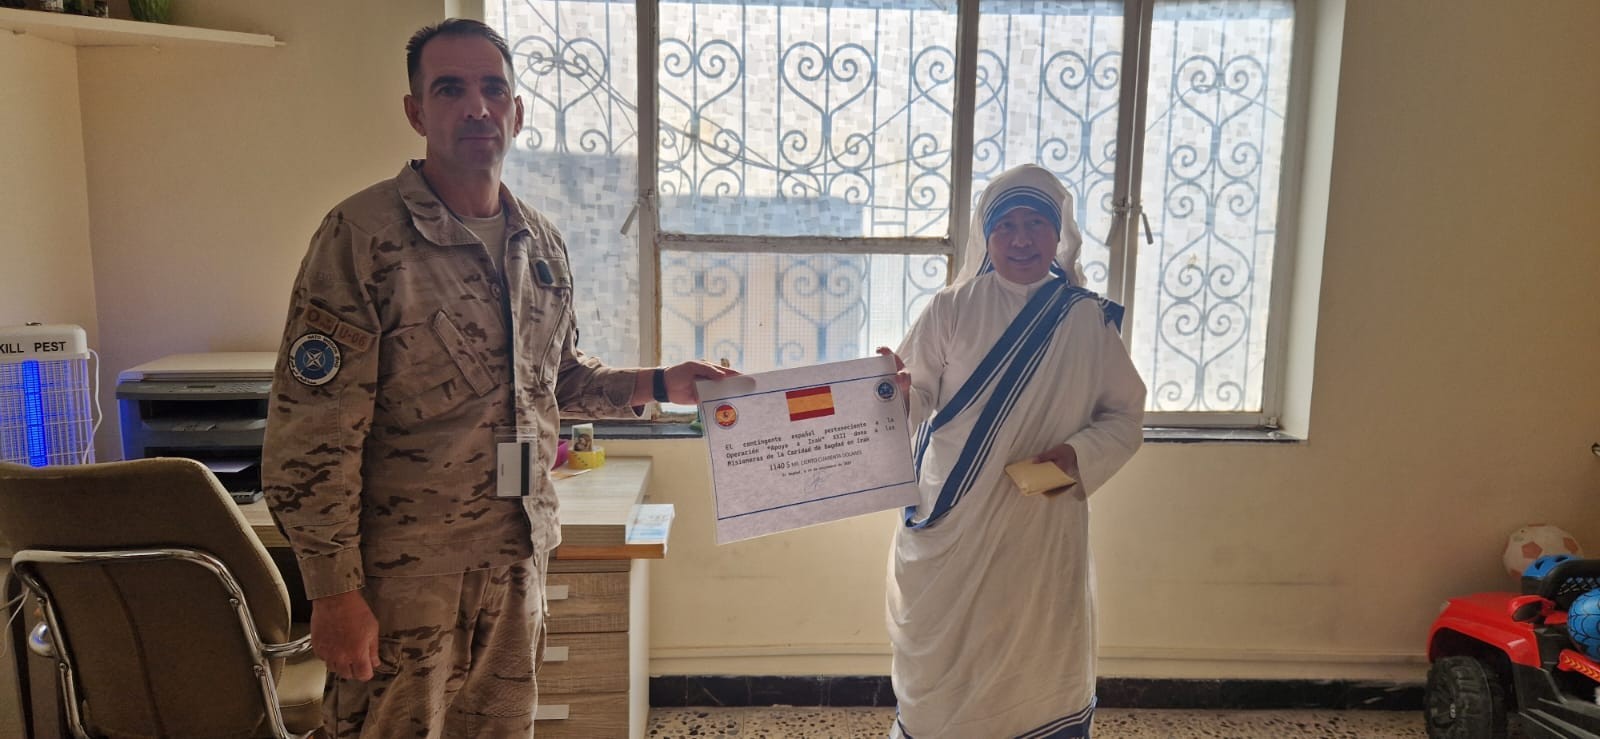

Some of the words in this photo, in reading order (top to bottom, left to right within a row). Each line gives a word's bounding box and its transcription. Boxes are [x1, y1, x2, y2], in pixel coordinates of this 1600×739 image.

[0, 343, 24, 354] KILL
[34, 341, 67, 352] PEST
[743, 436, 782, 448] contingente
[791, 429, 815, 440] español
[824, 422, 867, 435] perteneciente
[726, 448, 759, 459] Operación
[727, 456, 763, 467] Misioneras
[787, 446, 812, 456] Caridad
[824, 441, 844, 450] Bagdad
[769, 462, 785, 471] 1140
